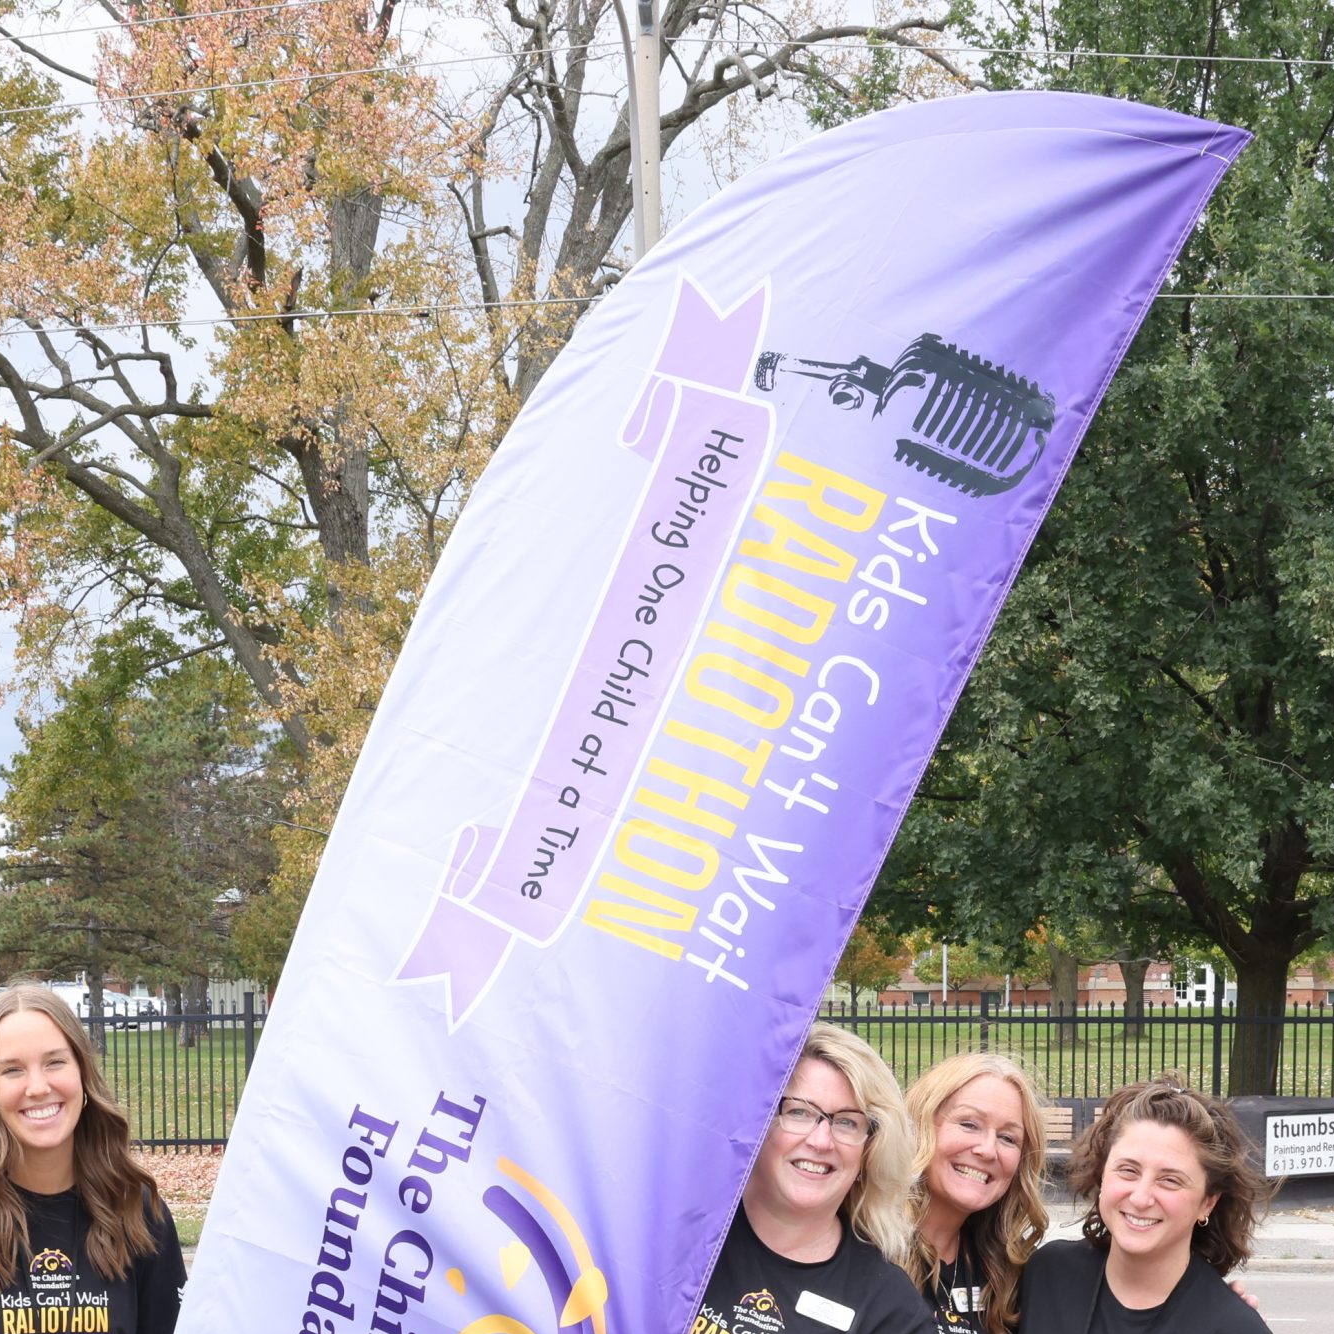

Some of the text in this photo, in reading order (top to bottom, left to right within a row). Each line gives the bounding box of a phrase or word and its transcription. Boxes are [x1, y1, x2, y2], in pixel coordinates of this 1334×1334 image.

[521, 430, 745, 900] Helping One Child at a Time
[581, 451, 887, 962] RADIOTHON
[686, 497, 957, 990] Kids Can't Wait
[398, 1090, 487, 1214] The
[1273, 1145, 1305, 1155] Painting
[1307, 1142, 1321, 1153] and
[32, 1281, 72, 1289] Foundatio
[42, 1273, 80, 1281] Childres
[0, 1290, 109, 1308] Kids Can't Wait
[699, 1303, 728, 1329] Kids
[732, 1305, 785, 1329] The Children
[735, 1313, 779, 1332] Foundation
